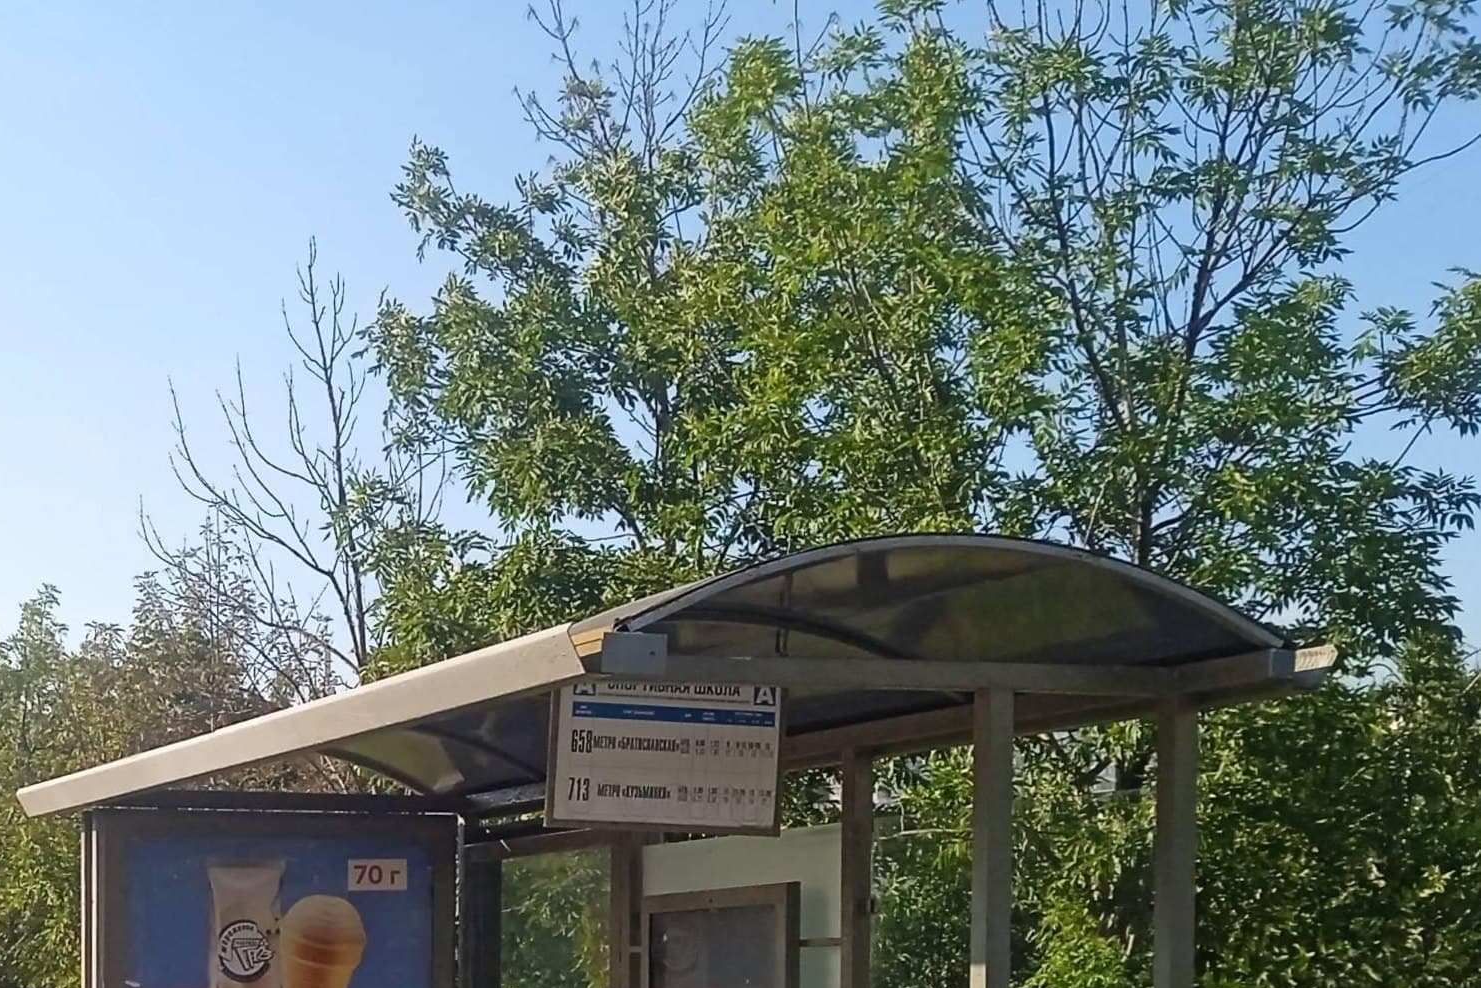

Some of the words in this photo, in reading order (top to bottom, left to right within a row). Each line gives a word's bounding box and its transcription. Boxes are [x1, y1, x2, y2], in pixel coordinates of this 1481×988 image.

[571, 729, 593, 753] 658
[593, 735, 617, 750] МЕТРО
[568, 777, 590, 801] 713
[597, 783, 620, 798] МЕТРО
[353, 865, 384, 885] 70
[390, 870, 401, 885] г
